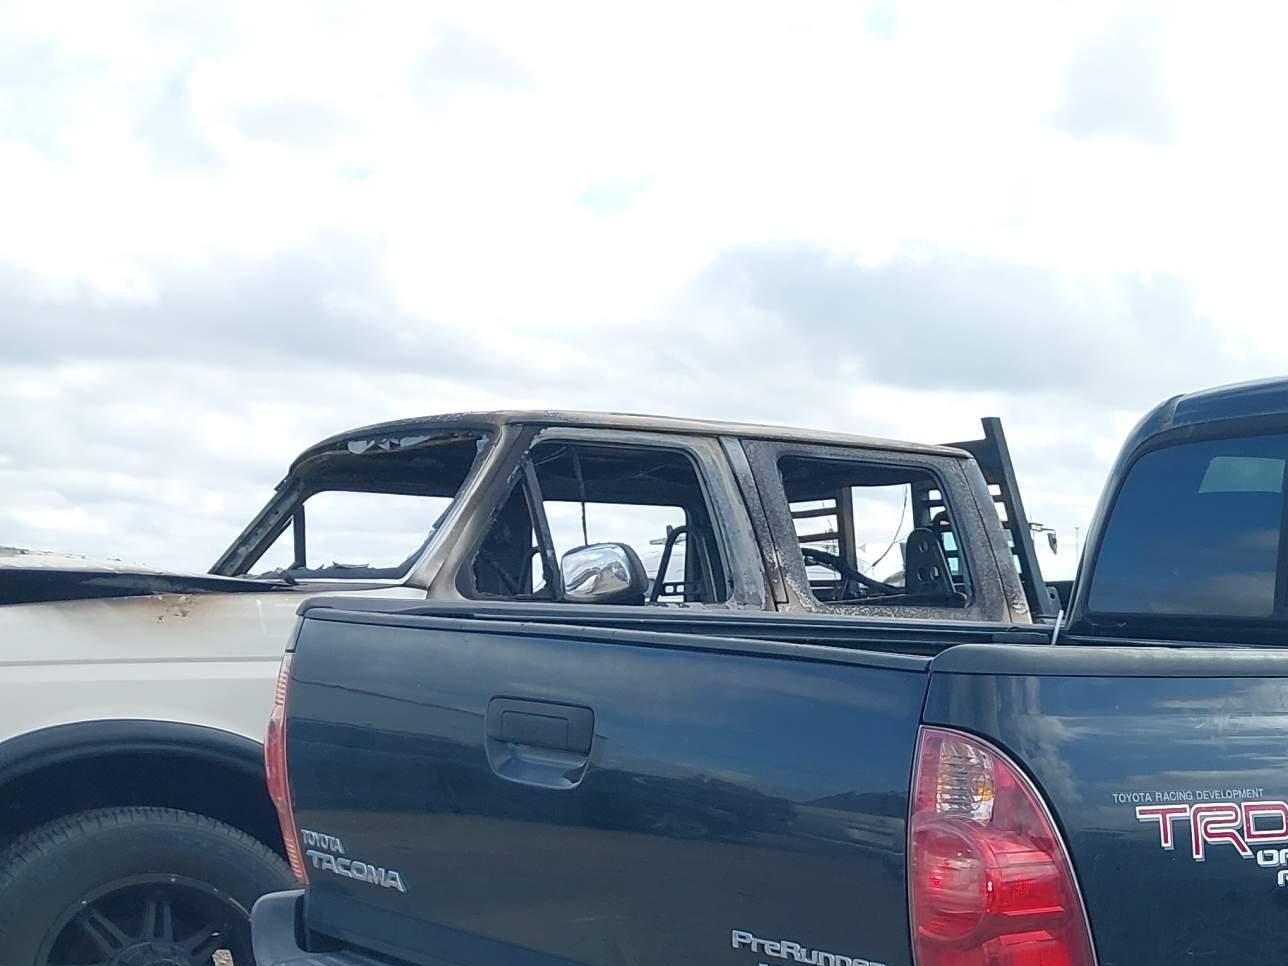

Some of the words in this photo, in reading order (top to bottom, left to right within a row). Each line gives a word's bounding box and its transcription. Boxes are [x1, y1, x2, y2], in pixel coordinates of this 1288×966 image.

[1112, 792, 1152, 803] TOYOTA
[1156, 790, 1194, 802] RACING
[1196, 788, 1265, 800] DEVELOPMENT
[301, 829, 345, 854] TOYOTA
[306, 849, 408, 893] TACOMA
